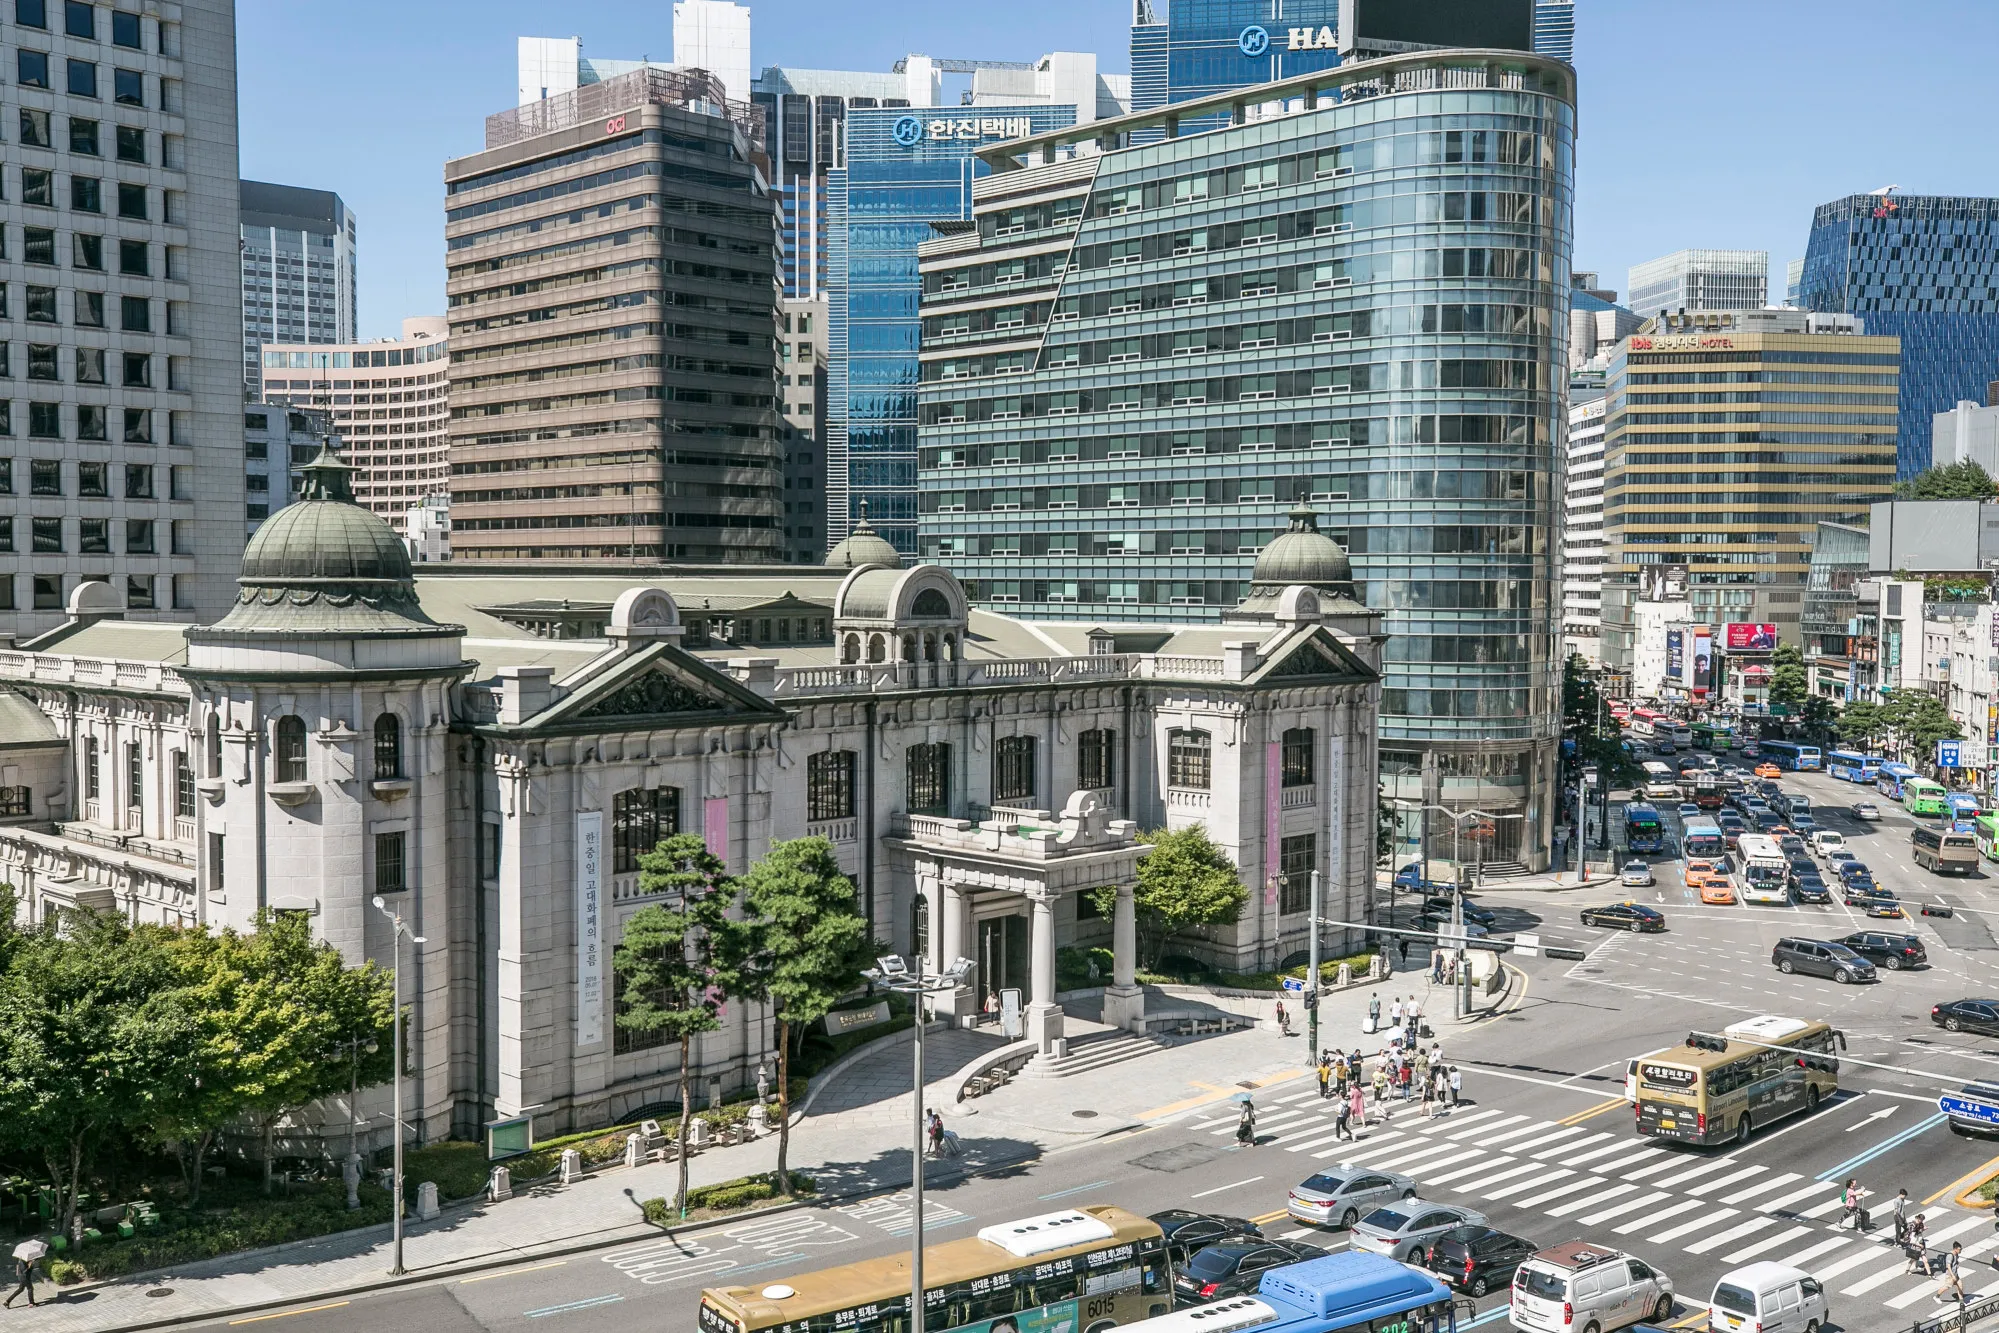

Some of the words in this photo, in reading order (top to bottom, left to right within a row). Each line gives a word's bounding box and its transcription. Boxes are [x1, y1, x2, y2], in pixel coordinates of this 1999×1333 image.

[1287, 26, 1339, 50] HA
[929, 117, 1031, 140] 한진택배
[1631, 337, 1652, 349] ibis
[1701, 338, 1734, 348] HOTEL
[586, 880, 598, 939] 고대화폐의
[586, 943, 598, 967] 흐름
[1959, 1102, 1981, 1112] 소공로
[1087, 1249, 1107, 1264] 인천공항
[1087, 1297, 1114, 1319] 6015
